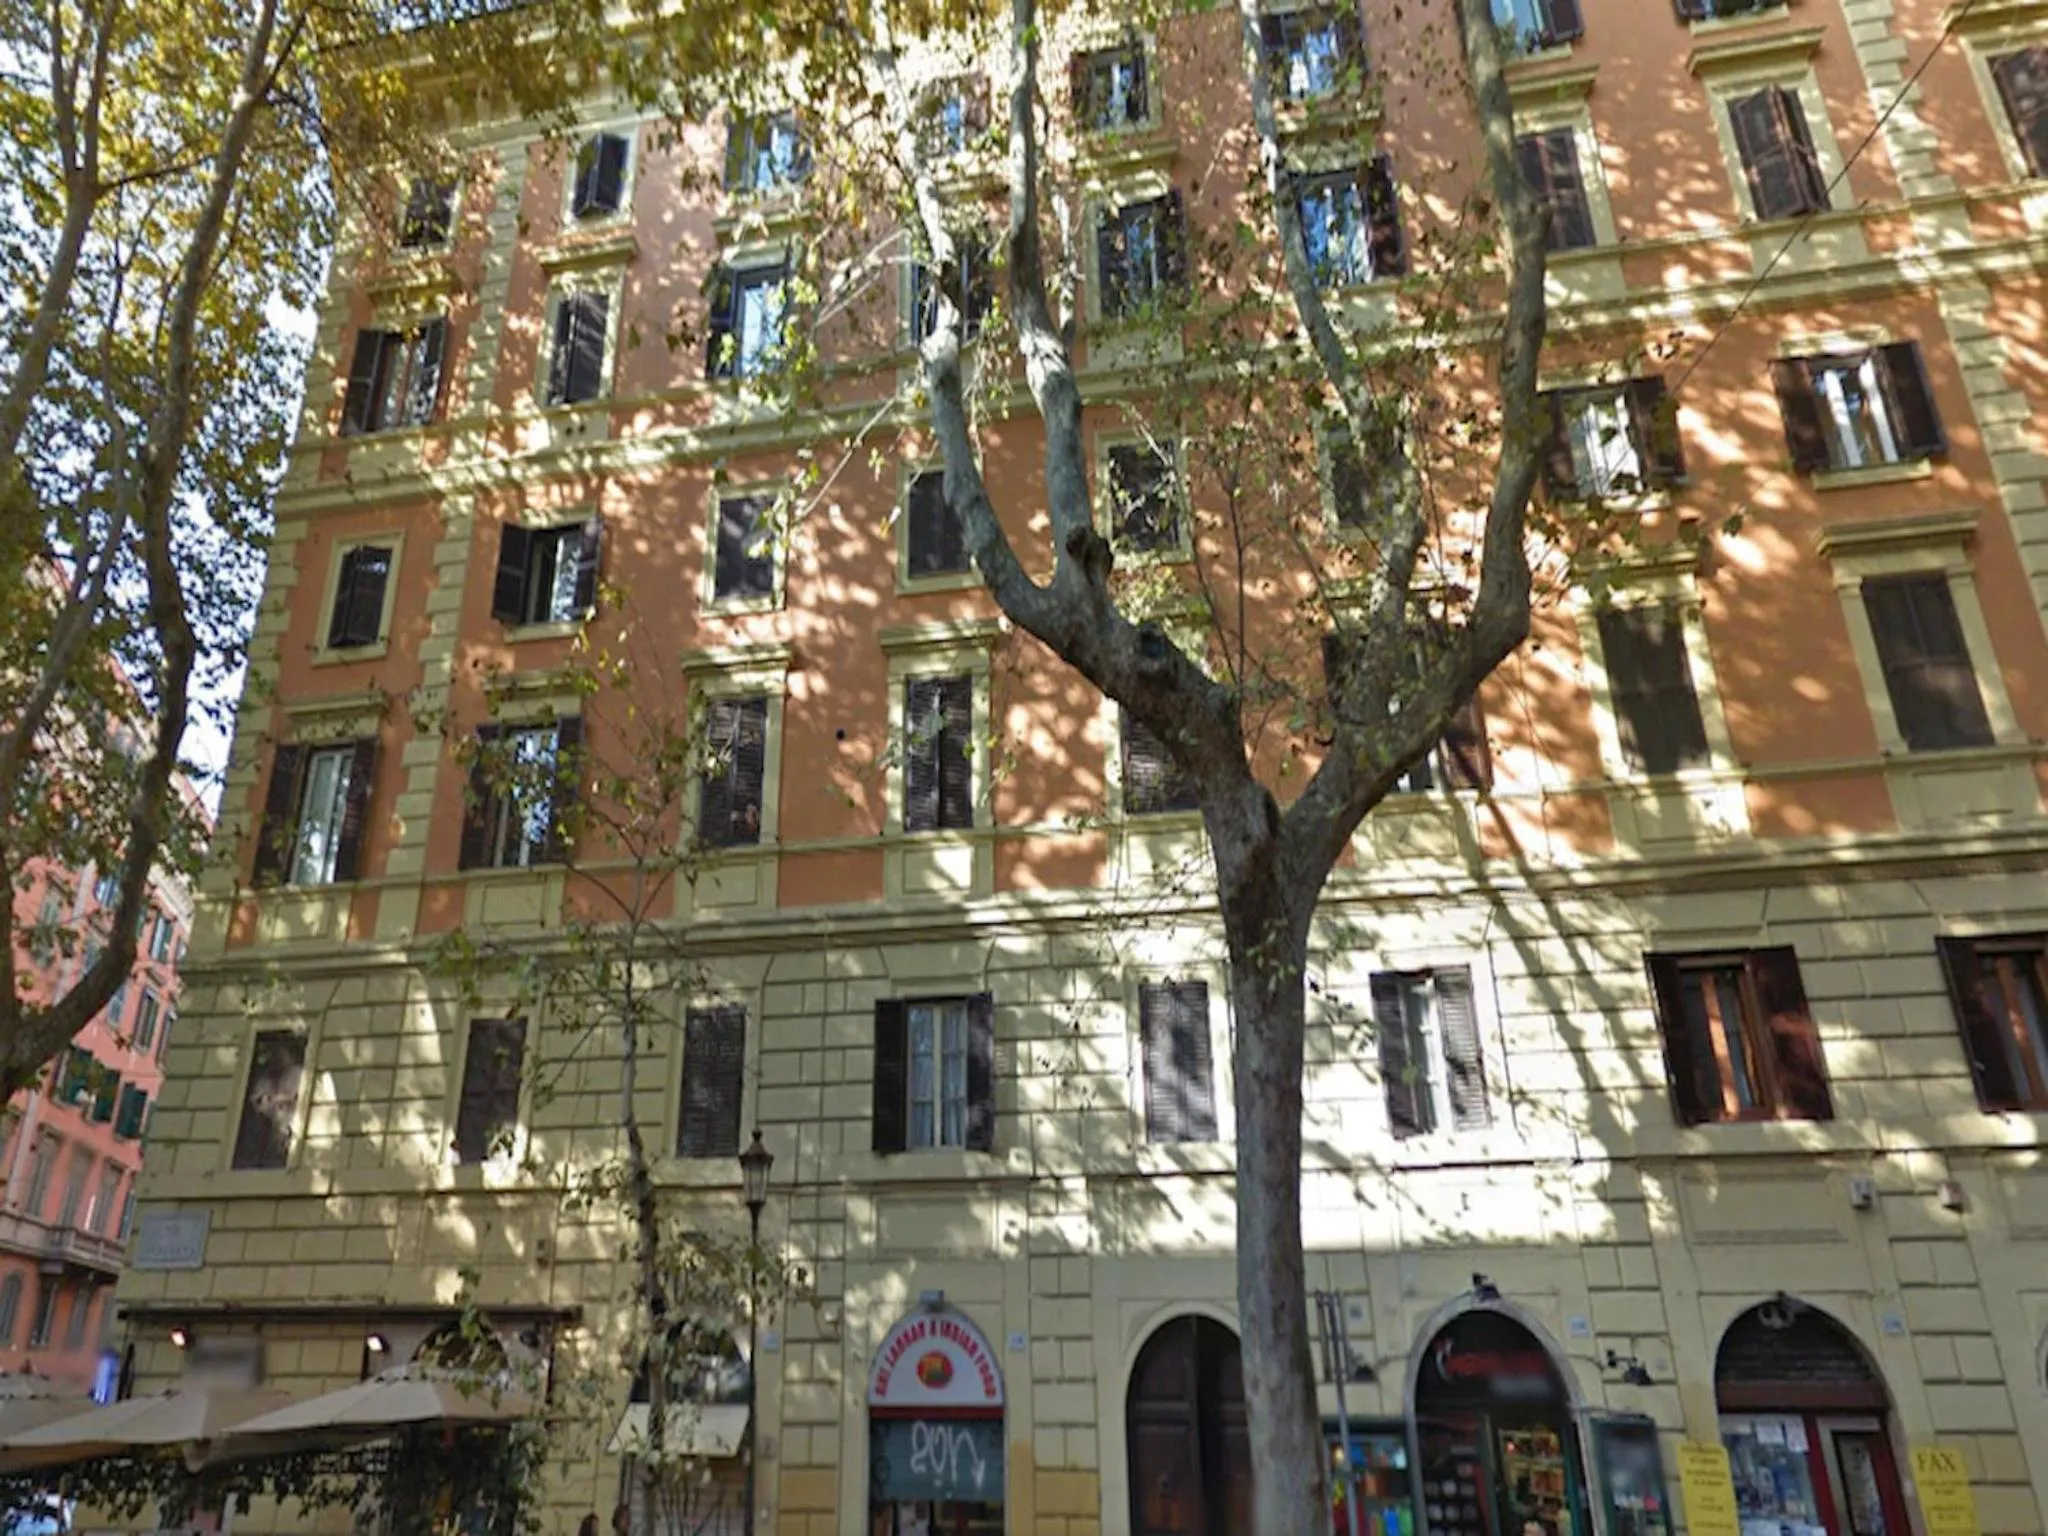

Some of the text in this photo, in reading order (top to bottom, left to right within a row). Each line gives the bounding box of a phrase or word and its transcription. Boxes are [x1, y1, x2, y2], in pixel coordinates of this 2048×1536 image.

[885, 1320, 926, 1367] LANKAN
[940, 1320, 978, 1358] INDIAN
[975, 1352, 997, 1398] FOOD
[1916, 1451, 1956, 1473] FAX
